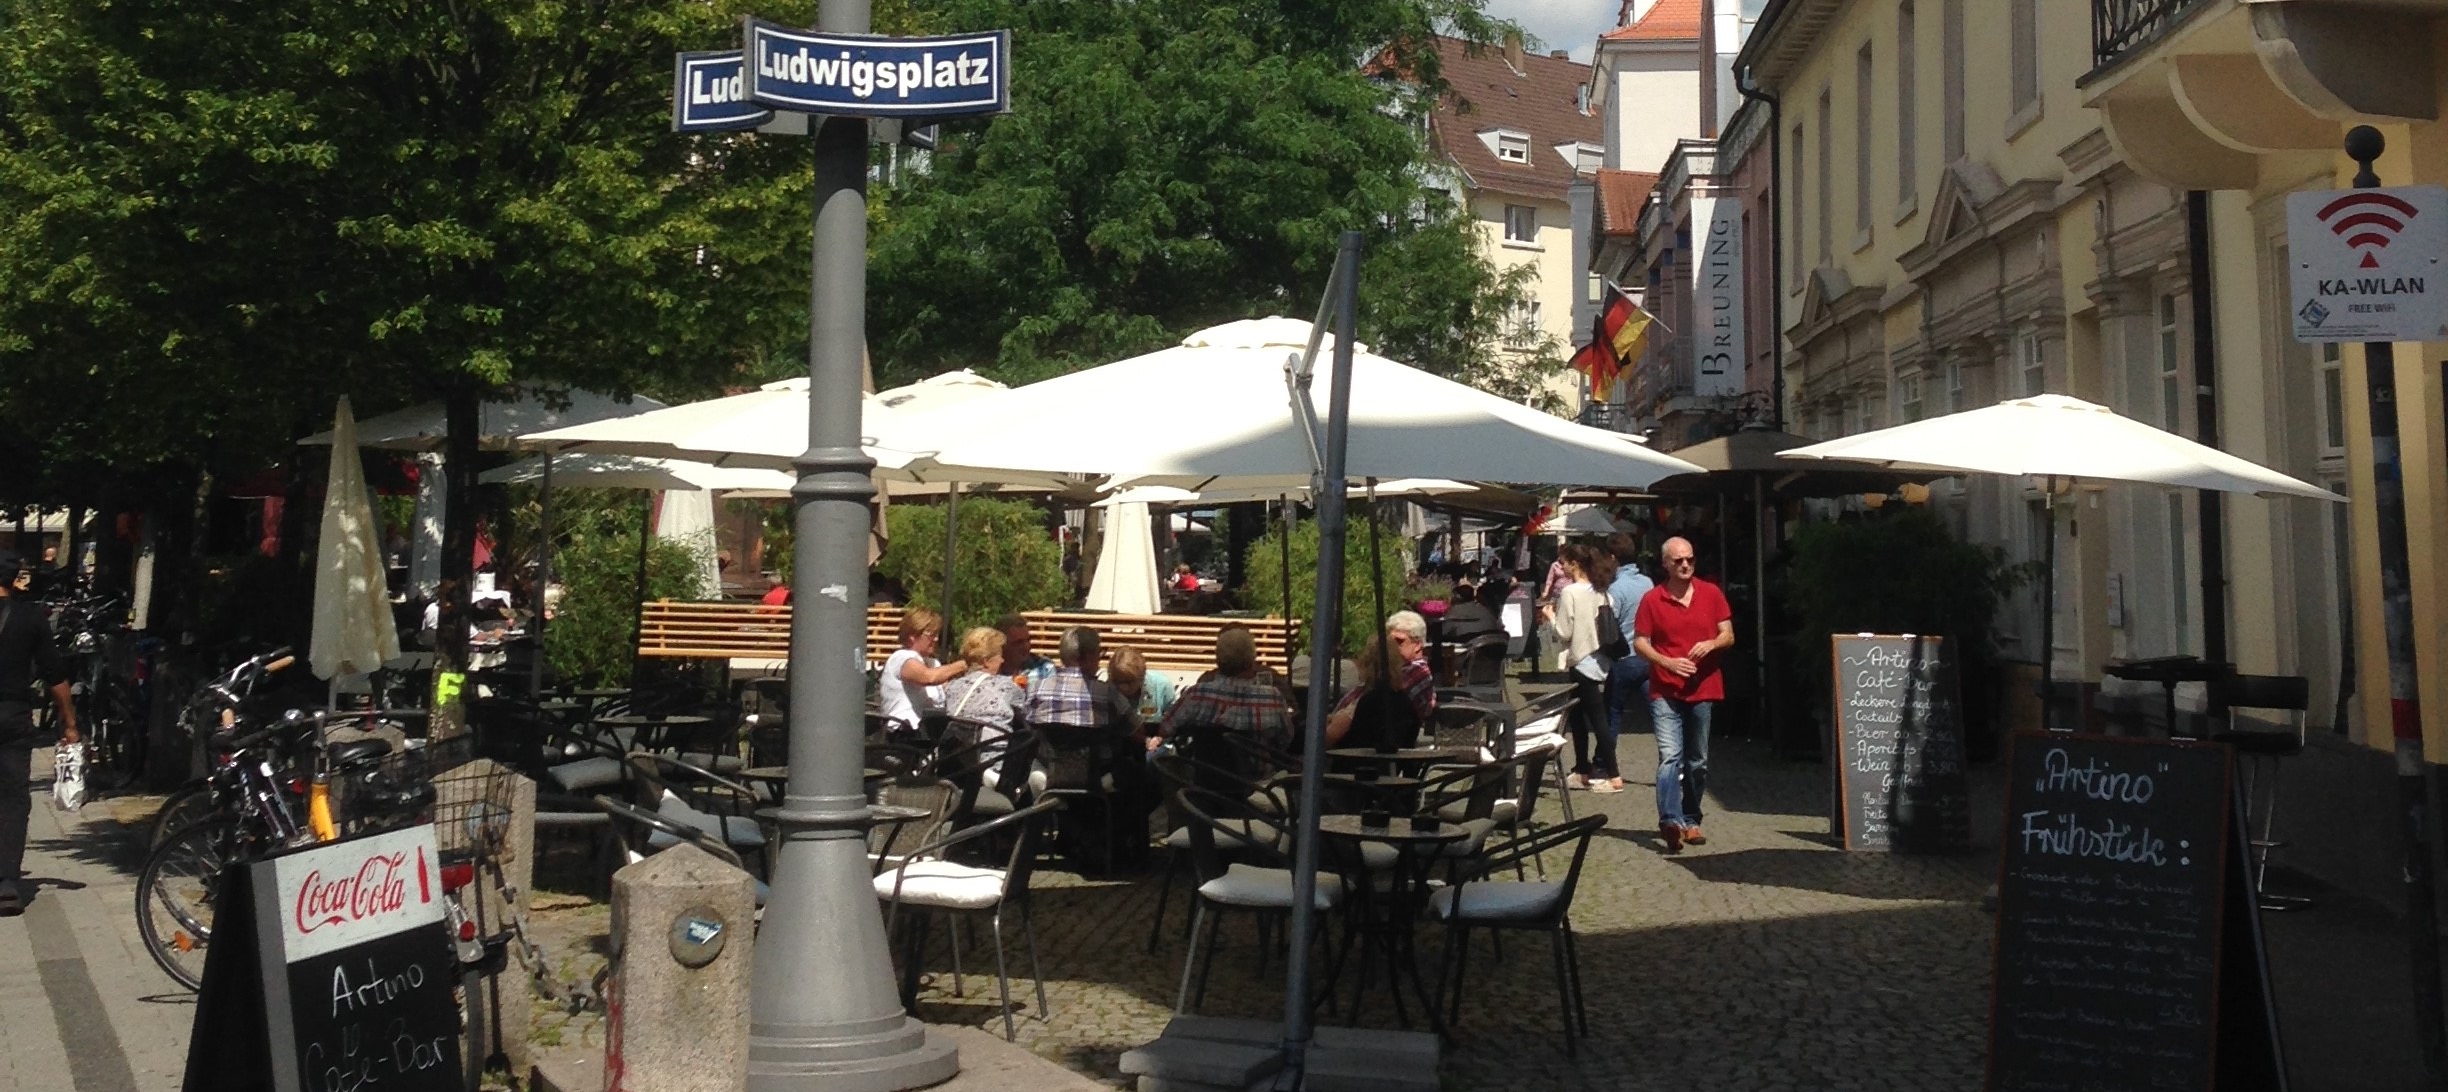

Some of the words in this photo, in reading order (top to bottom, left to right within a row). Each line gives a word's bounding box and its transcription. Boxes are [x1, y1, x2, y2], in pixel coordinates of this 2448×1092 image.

[759, 39, 989, 98] Ludwigsplatz
[1701, 219, 1732, 375] BREUNING
[2319, 277, 2424, 296] KA-WLAN
[2348, 304, 2372, 313] FREE
[296, 851, 408, 934] Coca-Cola
[332, 958, 424, 1019] Artino
